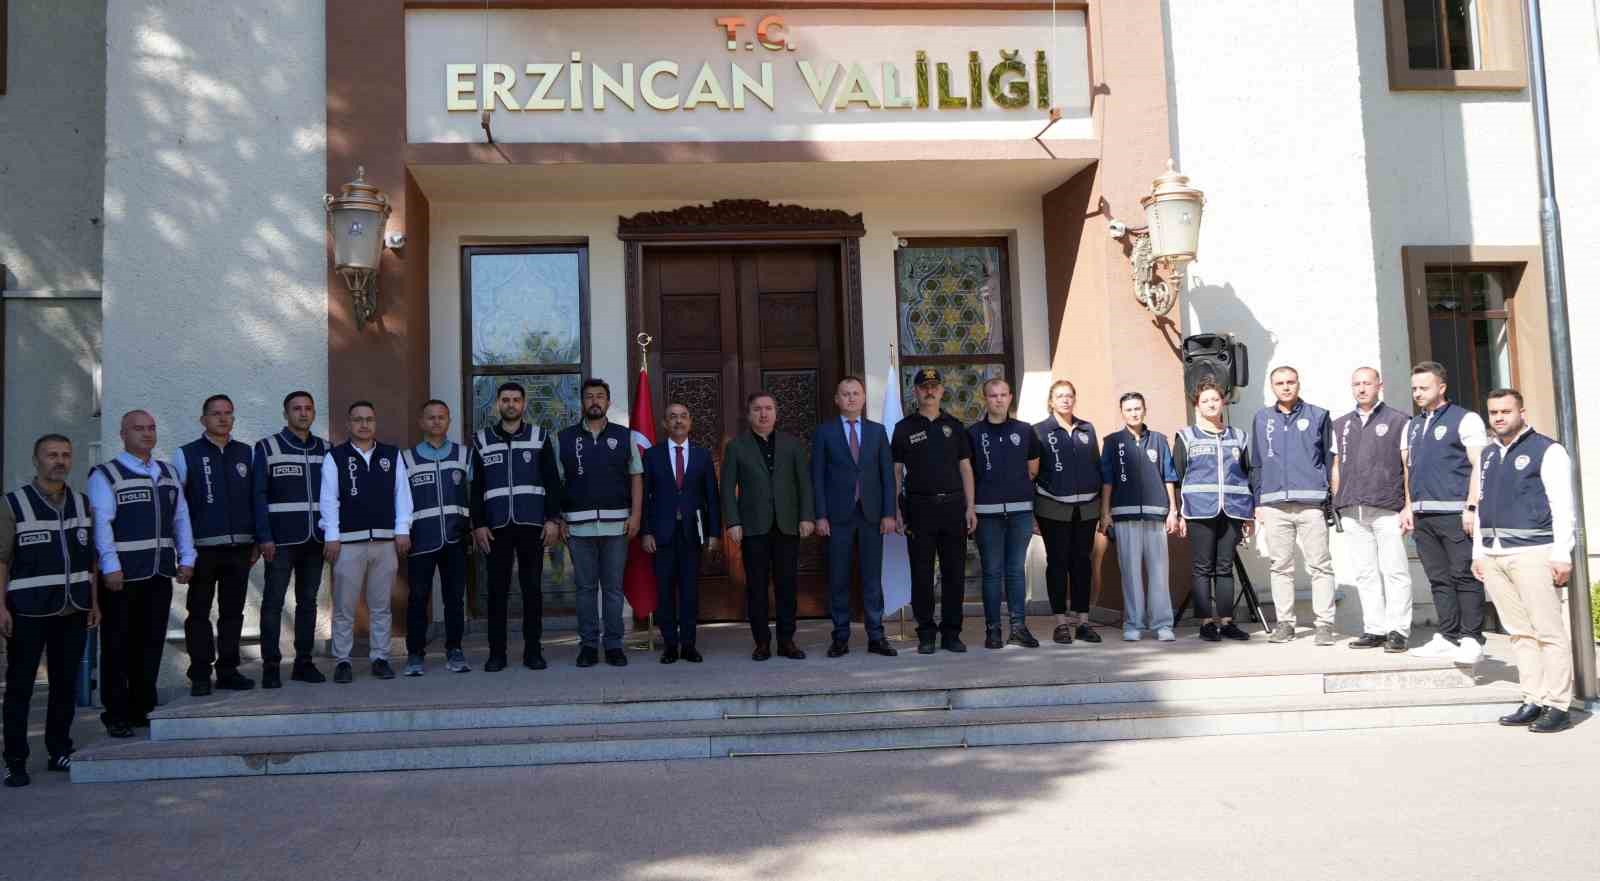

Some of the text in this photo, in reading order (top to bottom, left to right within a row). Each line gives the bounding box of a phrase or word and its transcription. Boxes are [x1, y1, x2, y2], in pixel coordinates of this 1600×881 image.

[715, 15, 796, 51] T.C.
[446, 49, 1050, 112] ERZİNCAN VALİLİĞİ
[348, 456, 359, 496] POLIS
